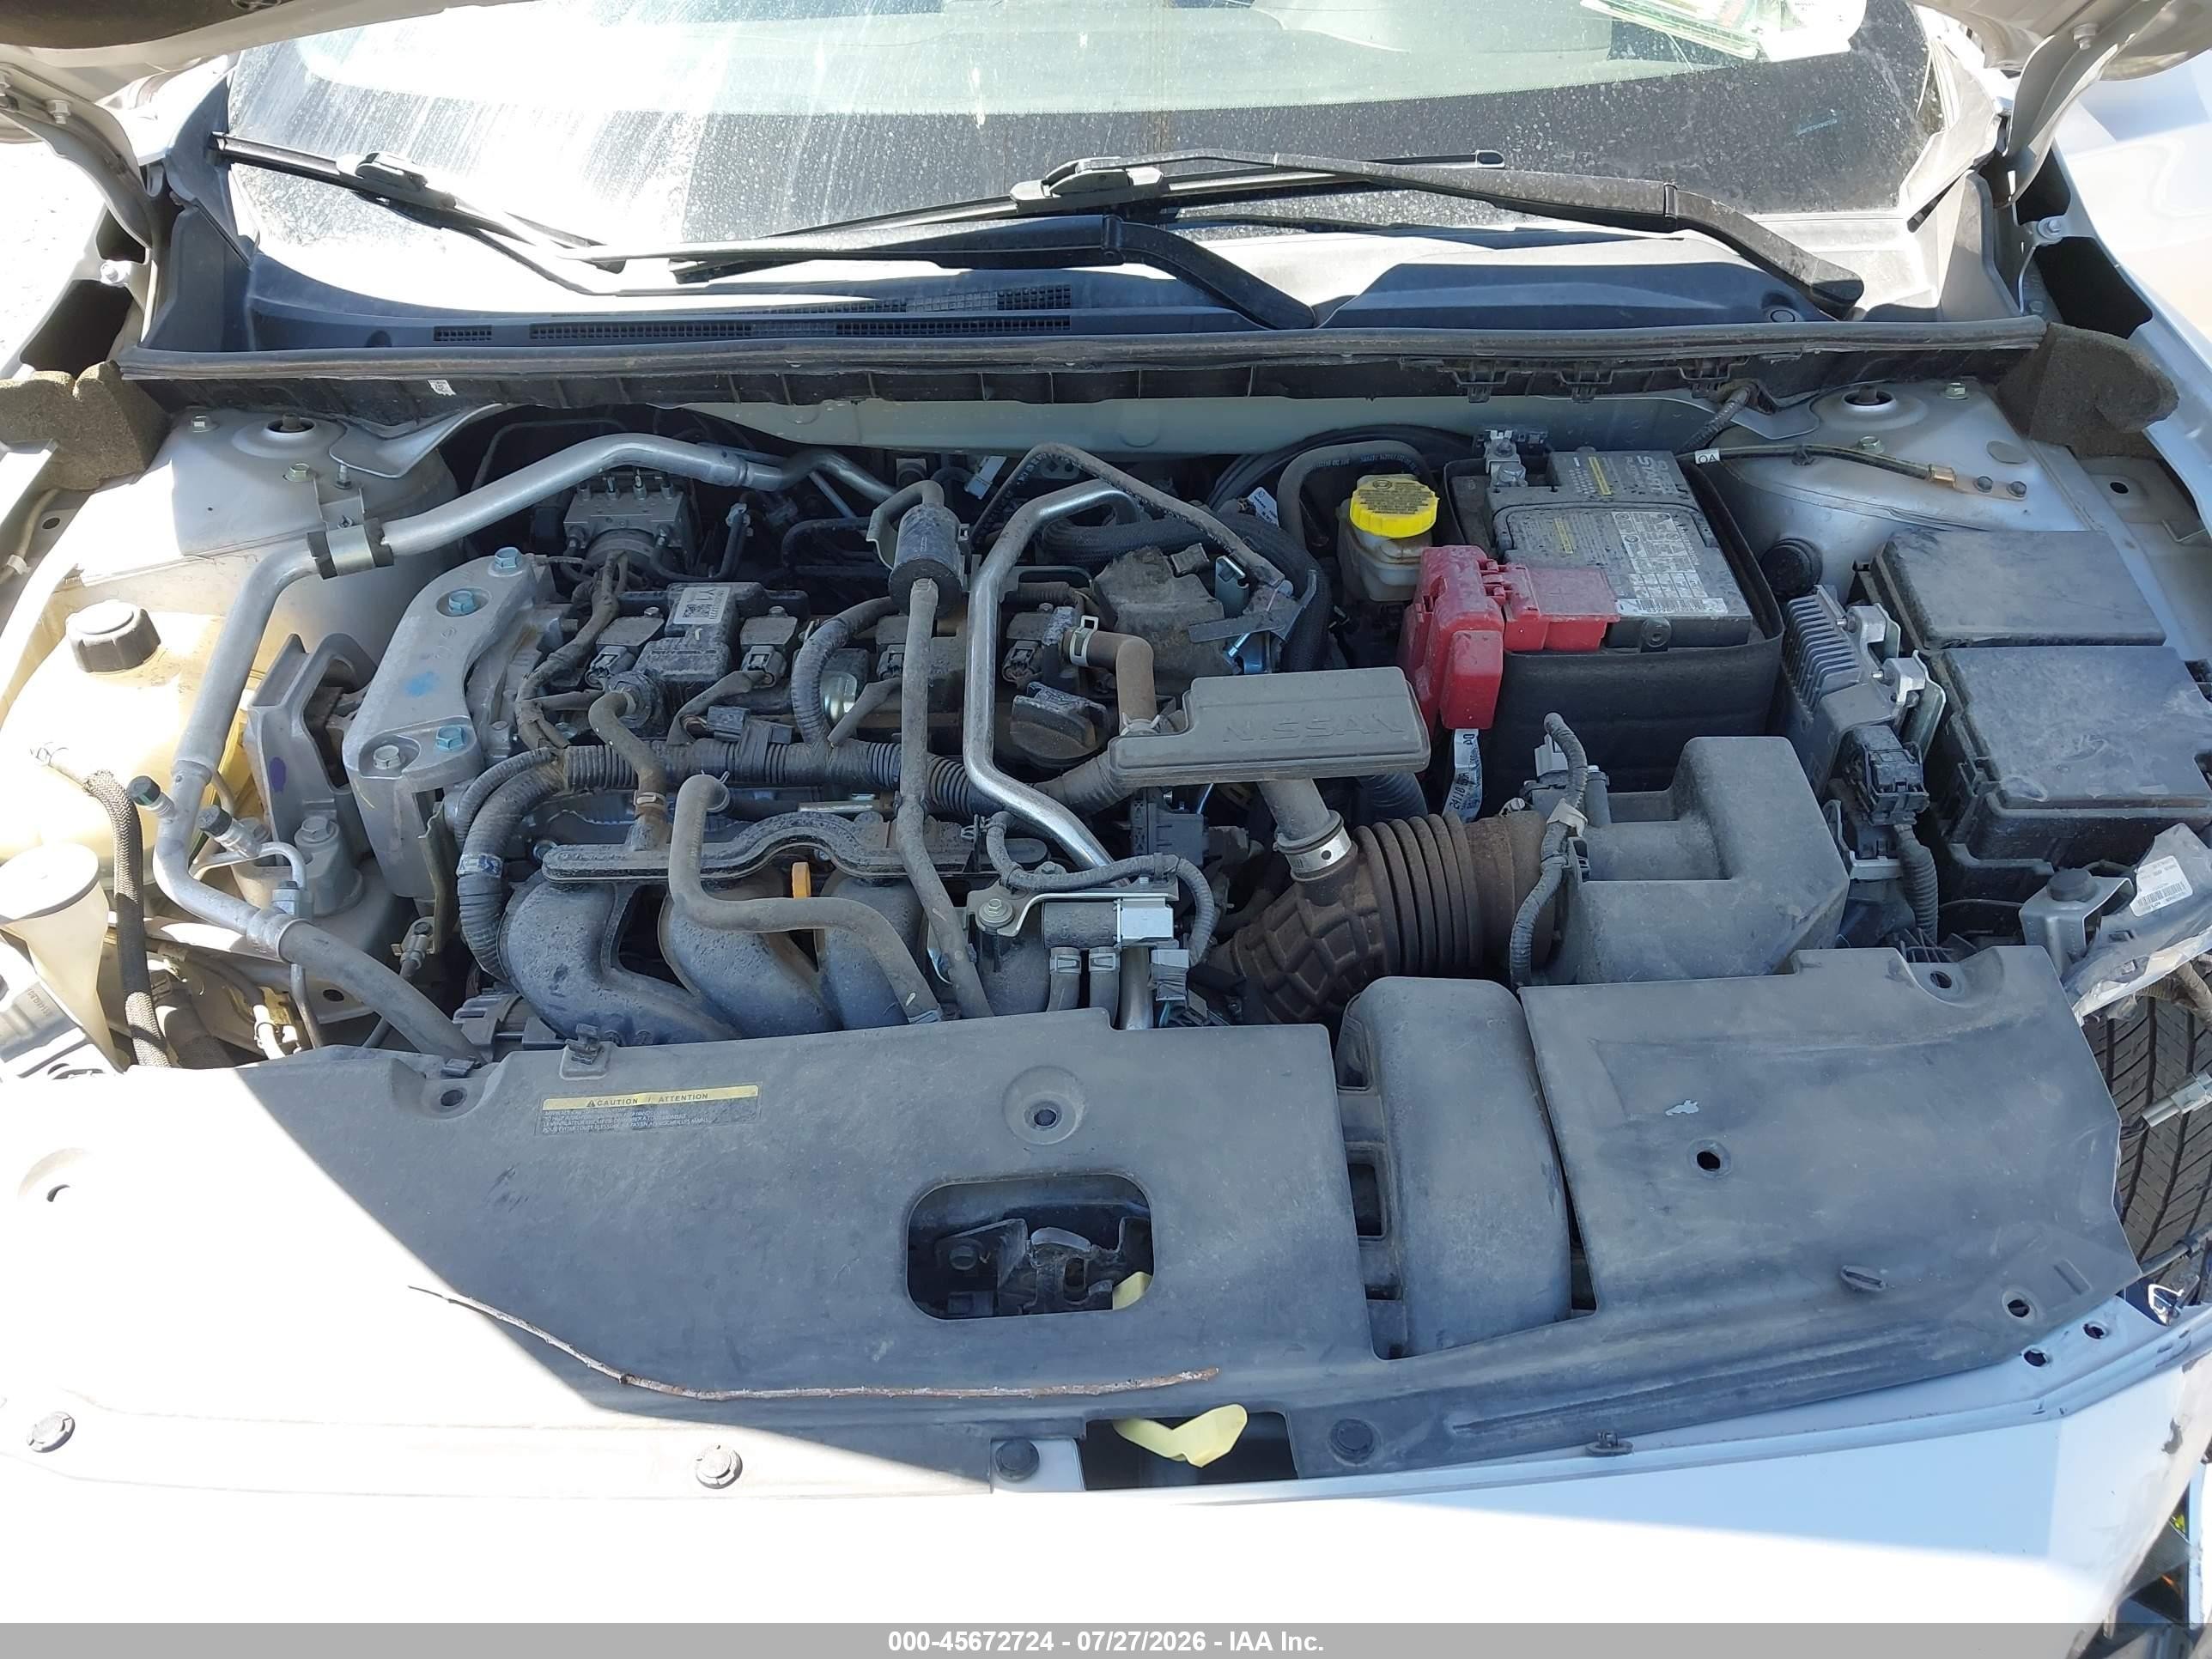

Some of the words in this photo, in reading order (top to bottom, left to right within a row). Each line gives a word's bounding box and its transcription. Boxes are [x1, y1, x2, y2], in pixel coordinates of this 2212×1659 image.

[1223, 714, 1405, 743] NISSAN
[597, 1098, 638, 1107] CAUTION
[658, 1093, 708, 1103] ATTENTION
